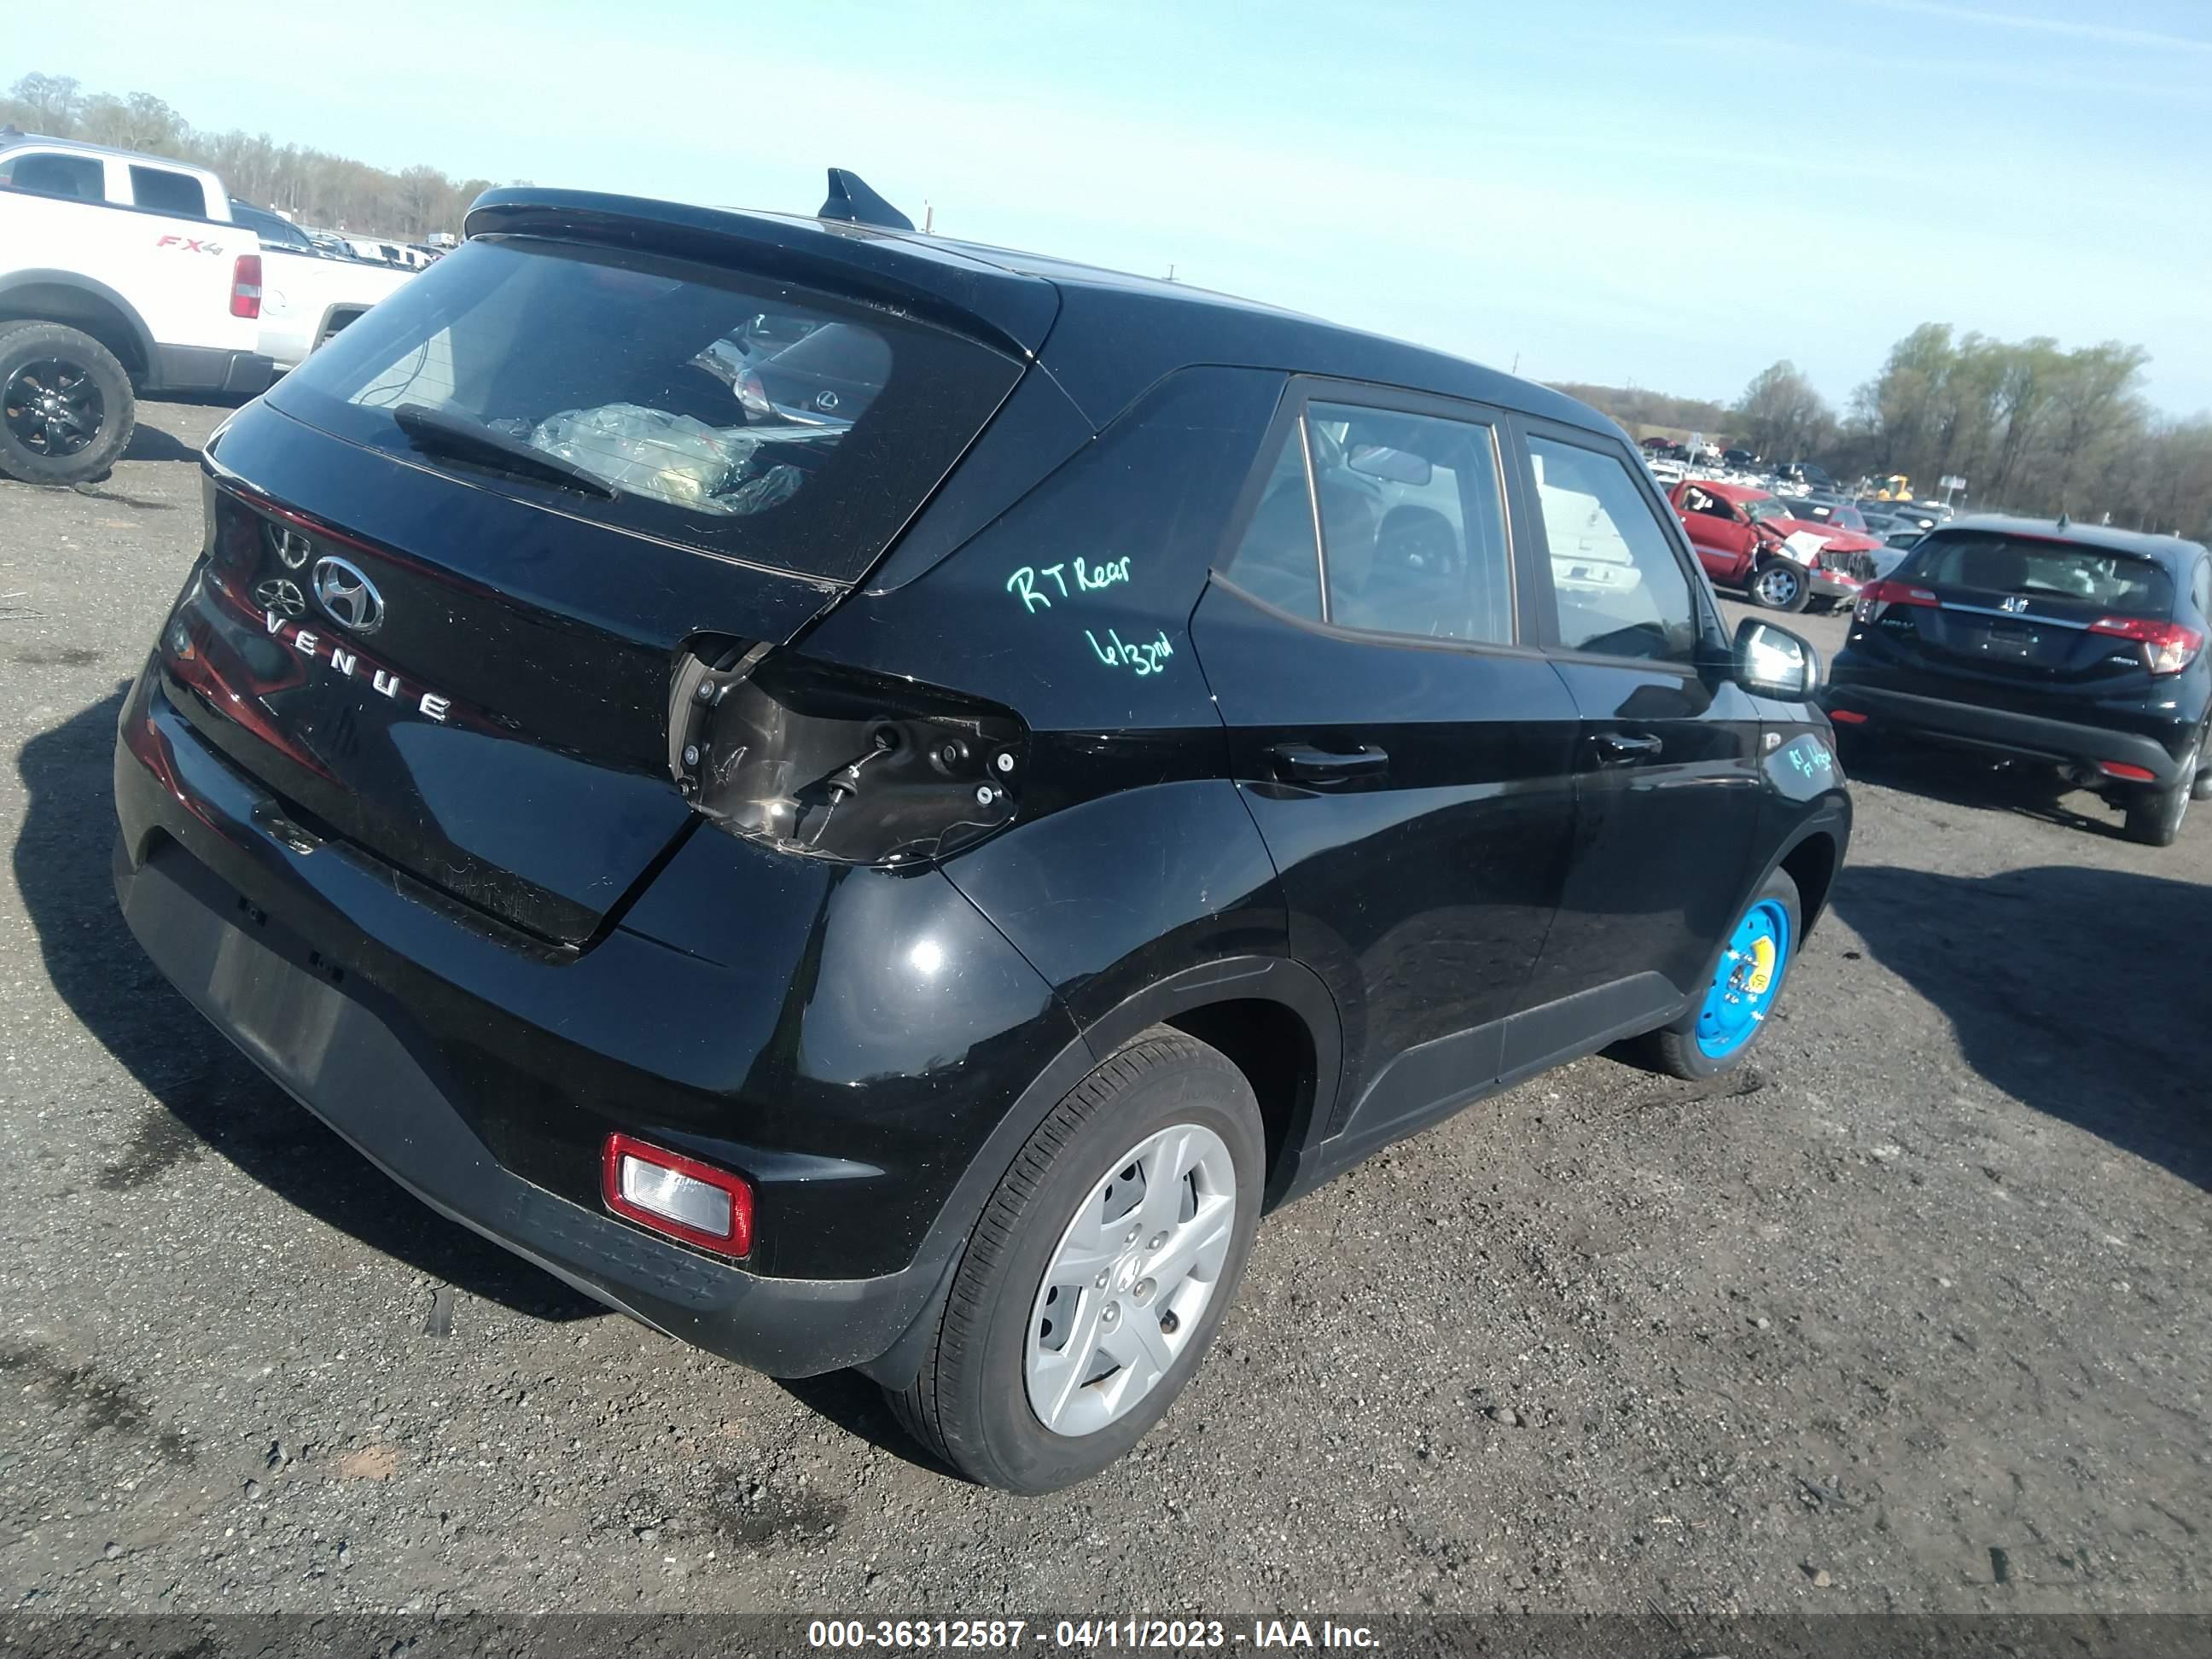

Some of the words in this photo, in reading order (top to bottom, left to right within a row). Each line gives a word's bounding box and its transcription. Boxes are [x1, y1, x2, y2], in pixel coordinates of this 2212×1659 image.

[156, 235, 224, 256] FX4
[1073, 556, 1132, 591] Rear
[265, 610, 451, 722] VENUE
